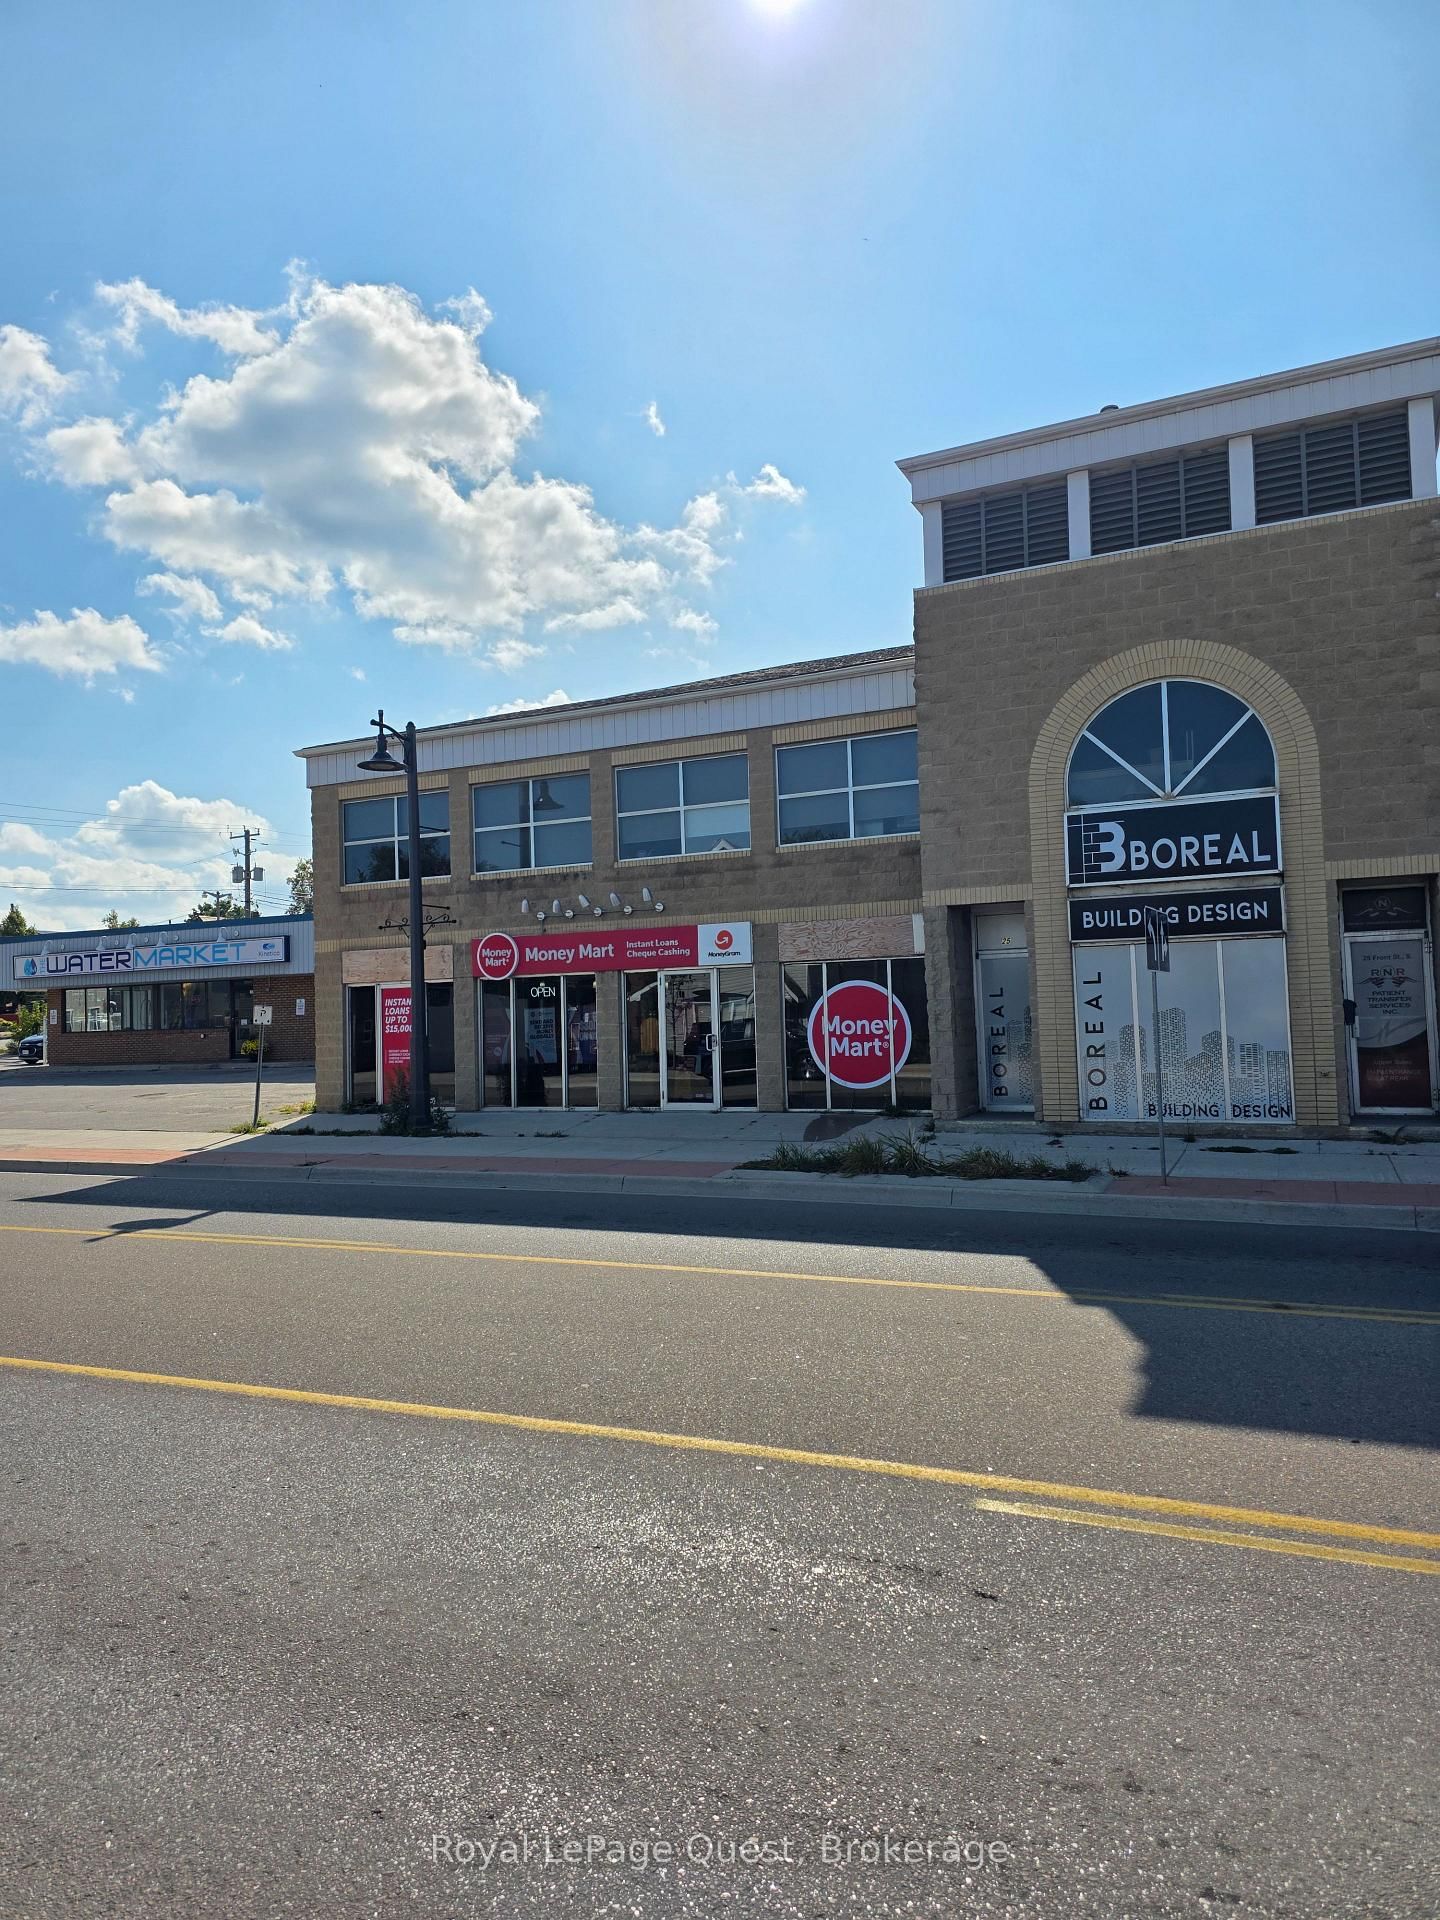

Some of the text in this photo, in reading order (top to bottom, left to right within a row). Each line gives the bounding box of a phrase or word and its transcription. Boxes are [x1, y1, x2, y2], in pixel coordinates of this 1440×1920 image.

[1129, 830, 1272, 871] BOREAL
[1082, 901, 1268, 929] BUILDG DESIGN
[626, 938, 679, 949] Instant Loans
[1001, 937, 1011, 945] 25
[47, 943, 246, 973] WATER MARKET
[481, 947, 512, 959] Money
[525, 943, 615, 965] Money Mart
[626, 947, 691, 959] Cheque Cashing
[530, 986, 556, 998] OPEN
[384, 998, 412, 1007] INSTAN
[384, 1007, 410, 1016] LOANS
[385, 1015, 408, 1024] UP TO
[821, 1015, 898, 1040] Money
[989, 987, 1009, 1097] BOREAL
[1083, 971, 1108, 1111] BOREAL
[1148, 1103, 1291, 1118] BUILDING DESIGN
